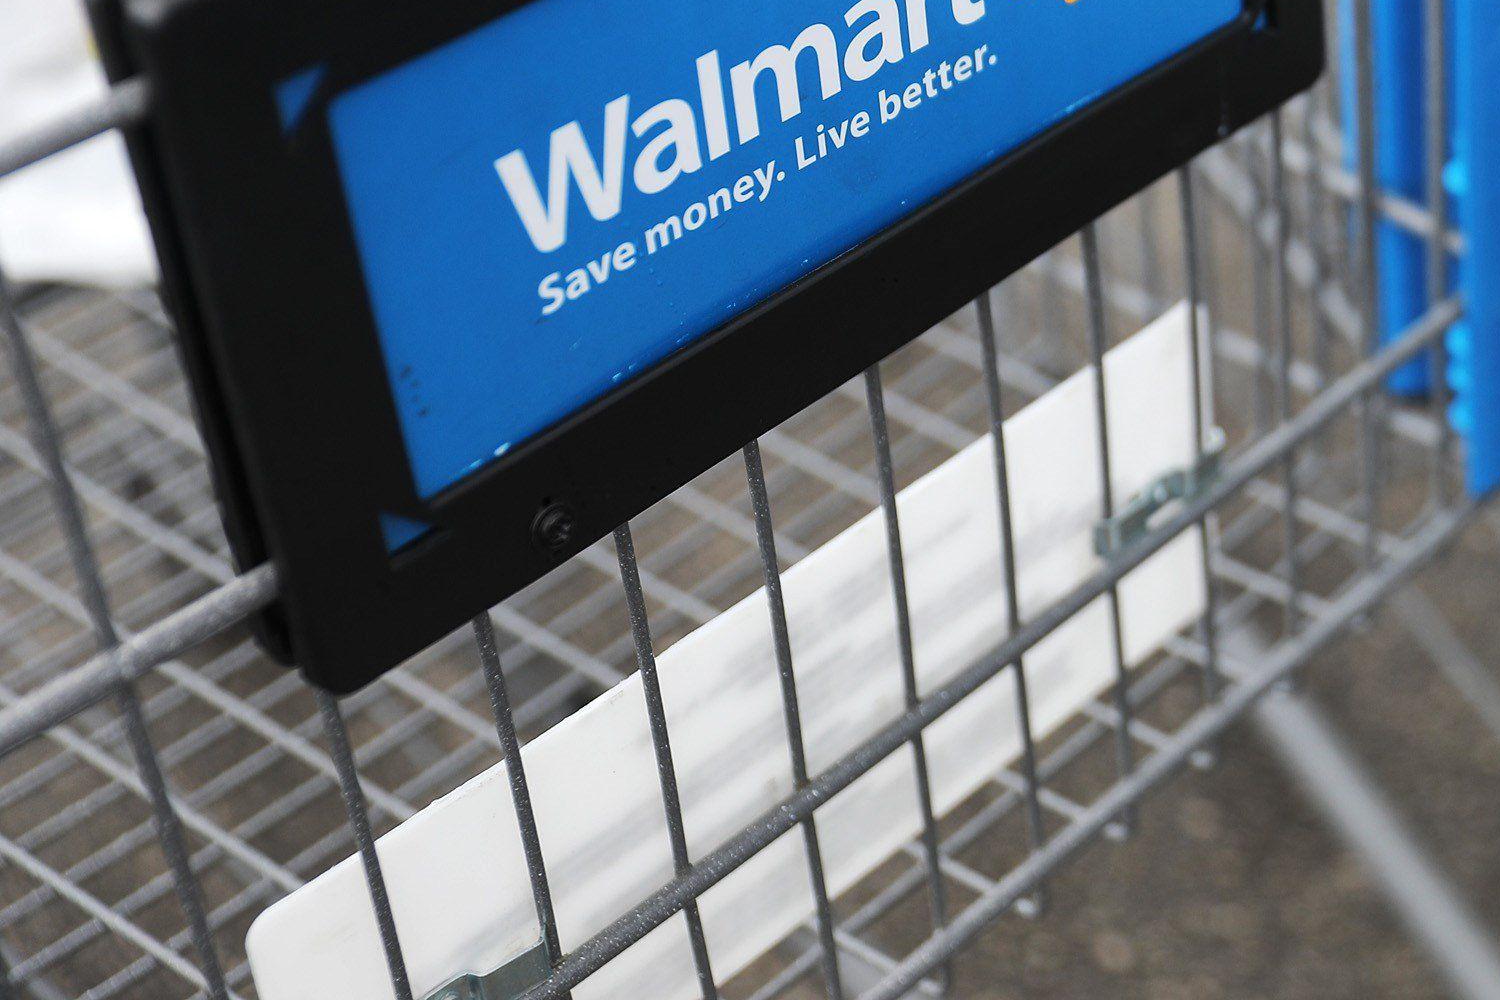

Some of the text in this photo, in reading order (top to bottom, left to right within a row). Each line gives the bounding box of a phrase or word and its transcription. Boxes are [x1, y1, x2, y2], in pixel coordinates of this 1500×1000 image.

[537, 44, 998, 317] Save money. Live better.
